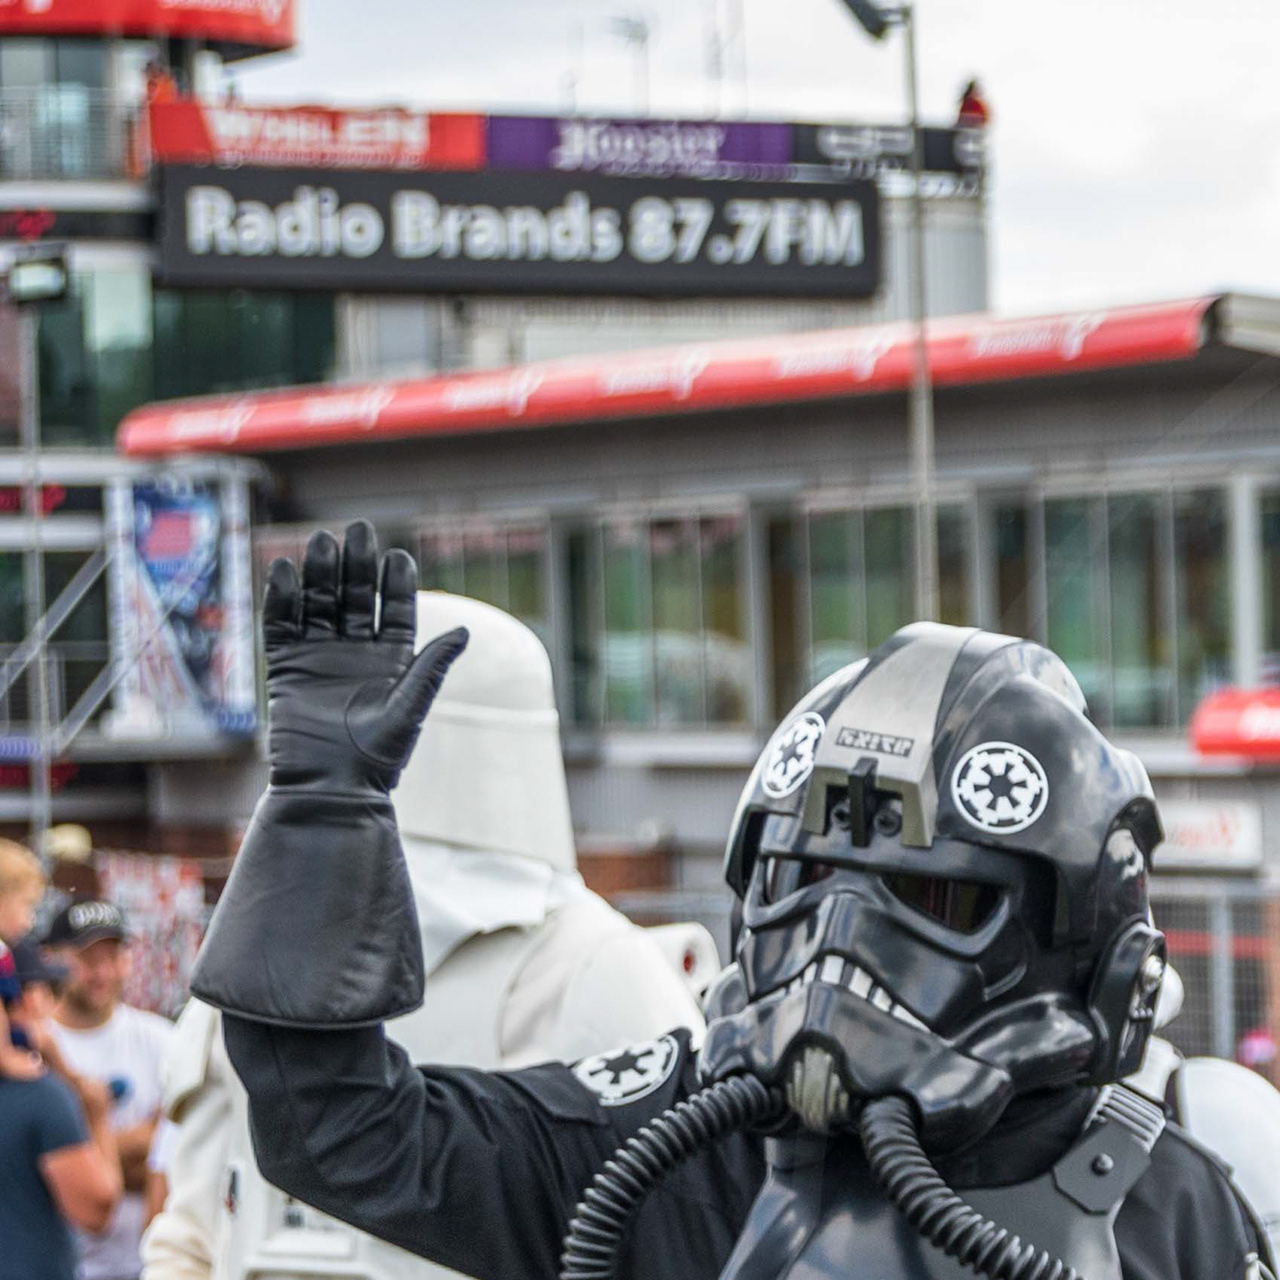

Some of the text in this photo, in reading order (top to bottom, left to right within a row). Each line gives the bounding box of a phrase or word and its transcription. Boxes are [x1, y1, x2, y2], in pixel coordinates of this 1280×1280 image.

[185, 184, 866, 267] Radio Brands 87.7FM
